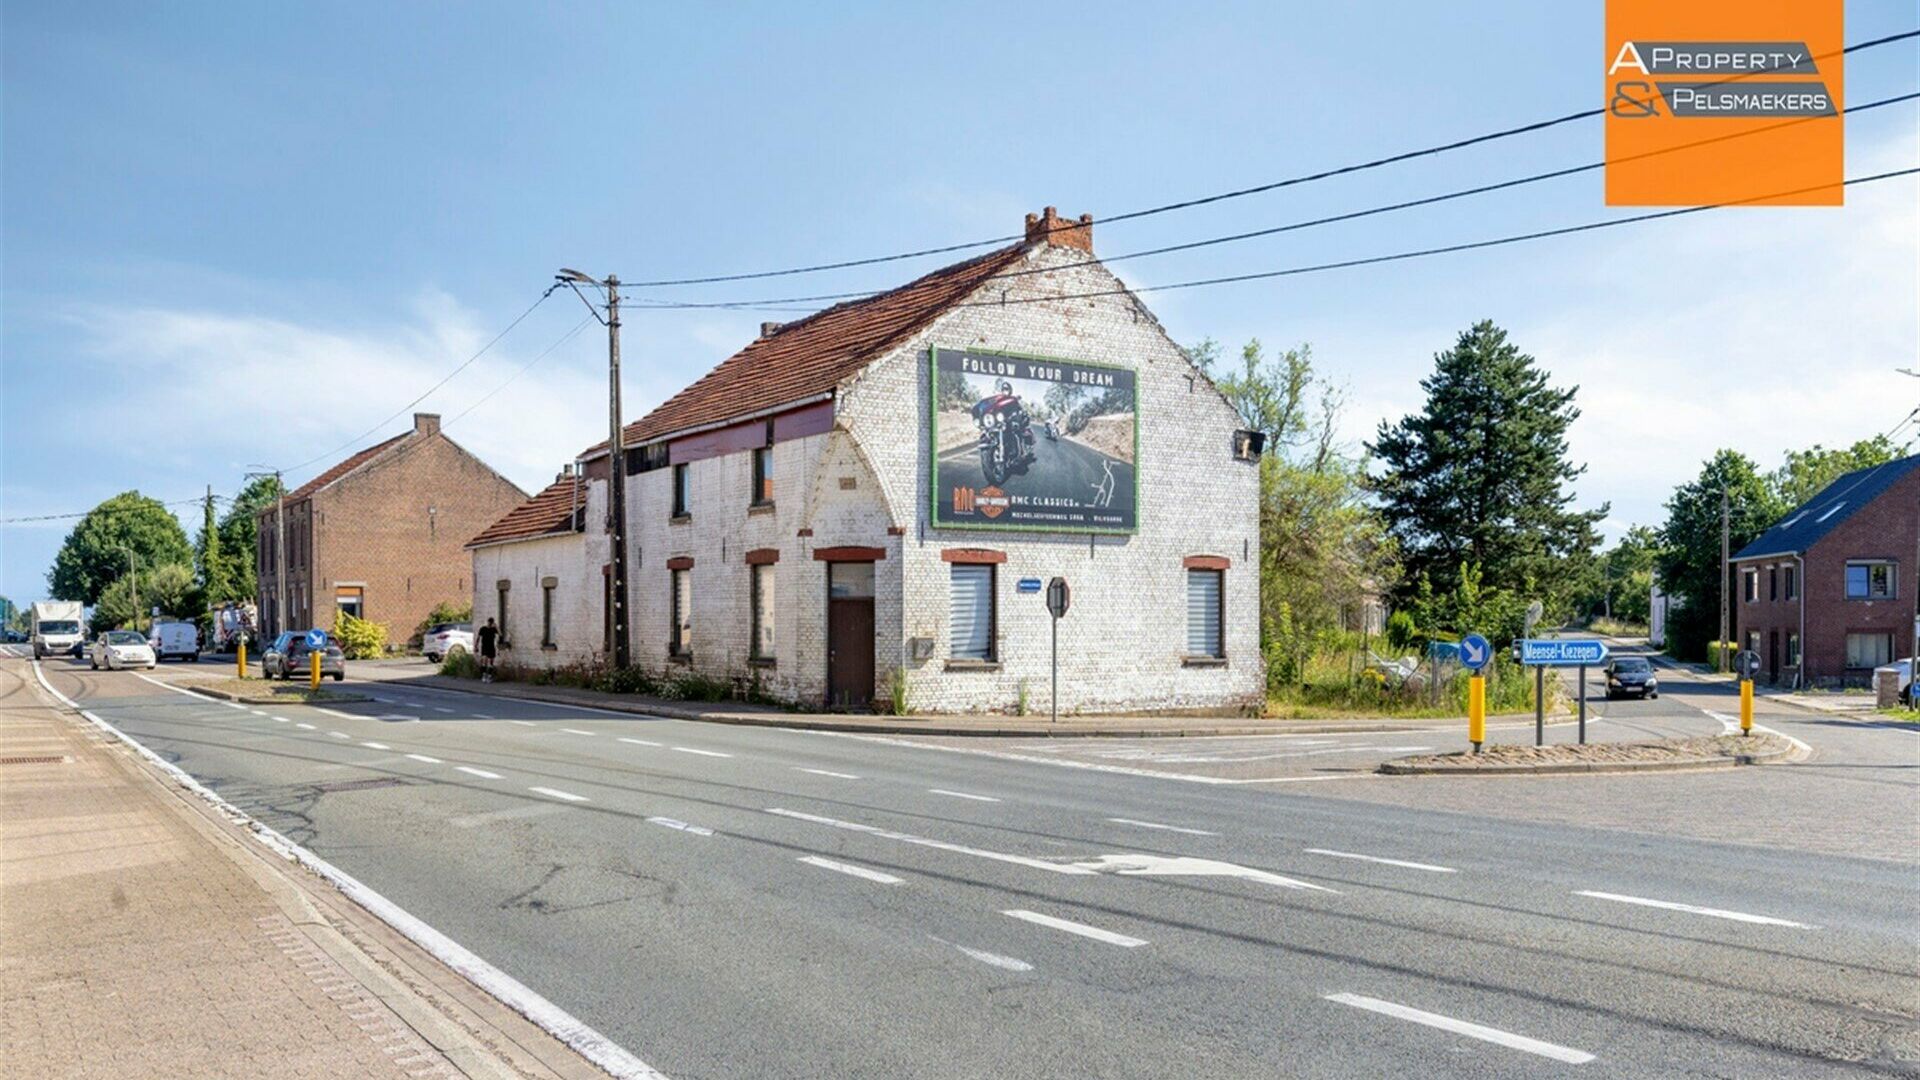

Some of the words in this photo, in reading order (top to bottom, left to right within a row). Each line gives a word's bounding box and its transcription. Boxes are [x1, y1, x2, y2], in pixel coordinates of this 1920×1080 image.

[962, 358, 1016, 376] FOLLOW
[1028, 365, 1062, 381] YOUR
[1073, 371, 1114, 386] DREAM
[1033, 497, 1074, 507] CLASSICS
